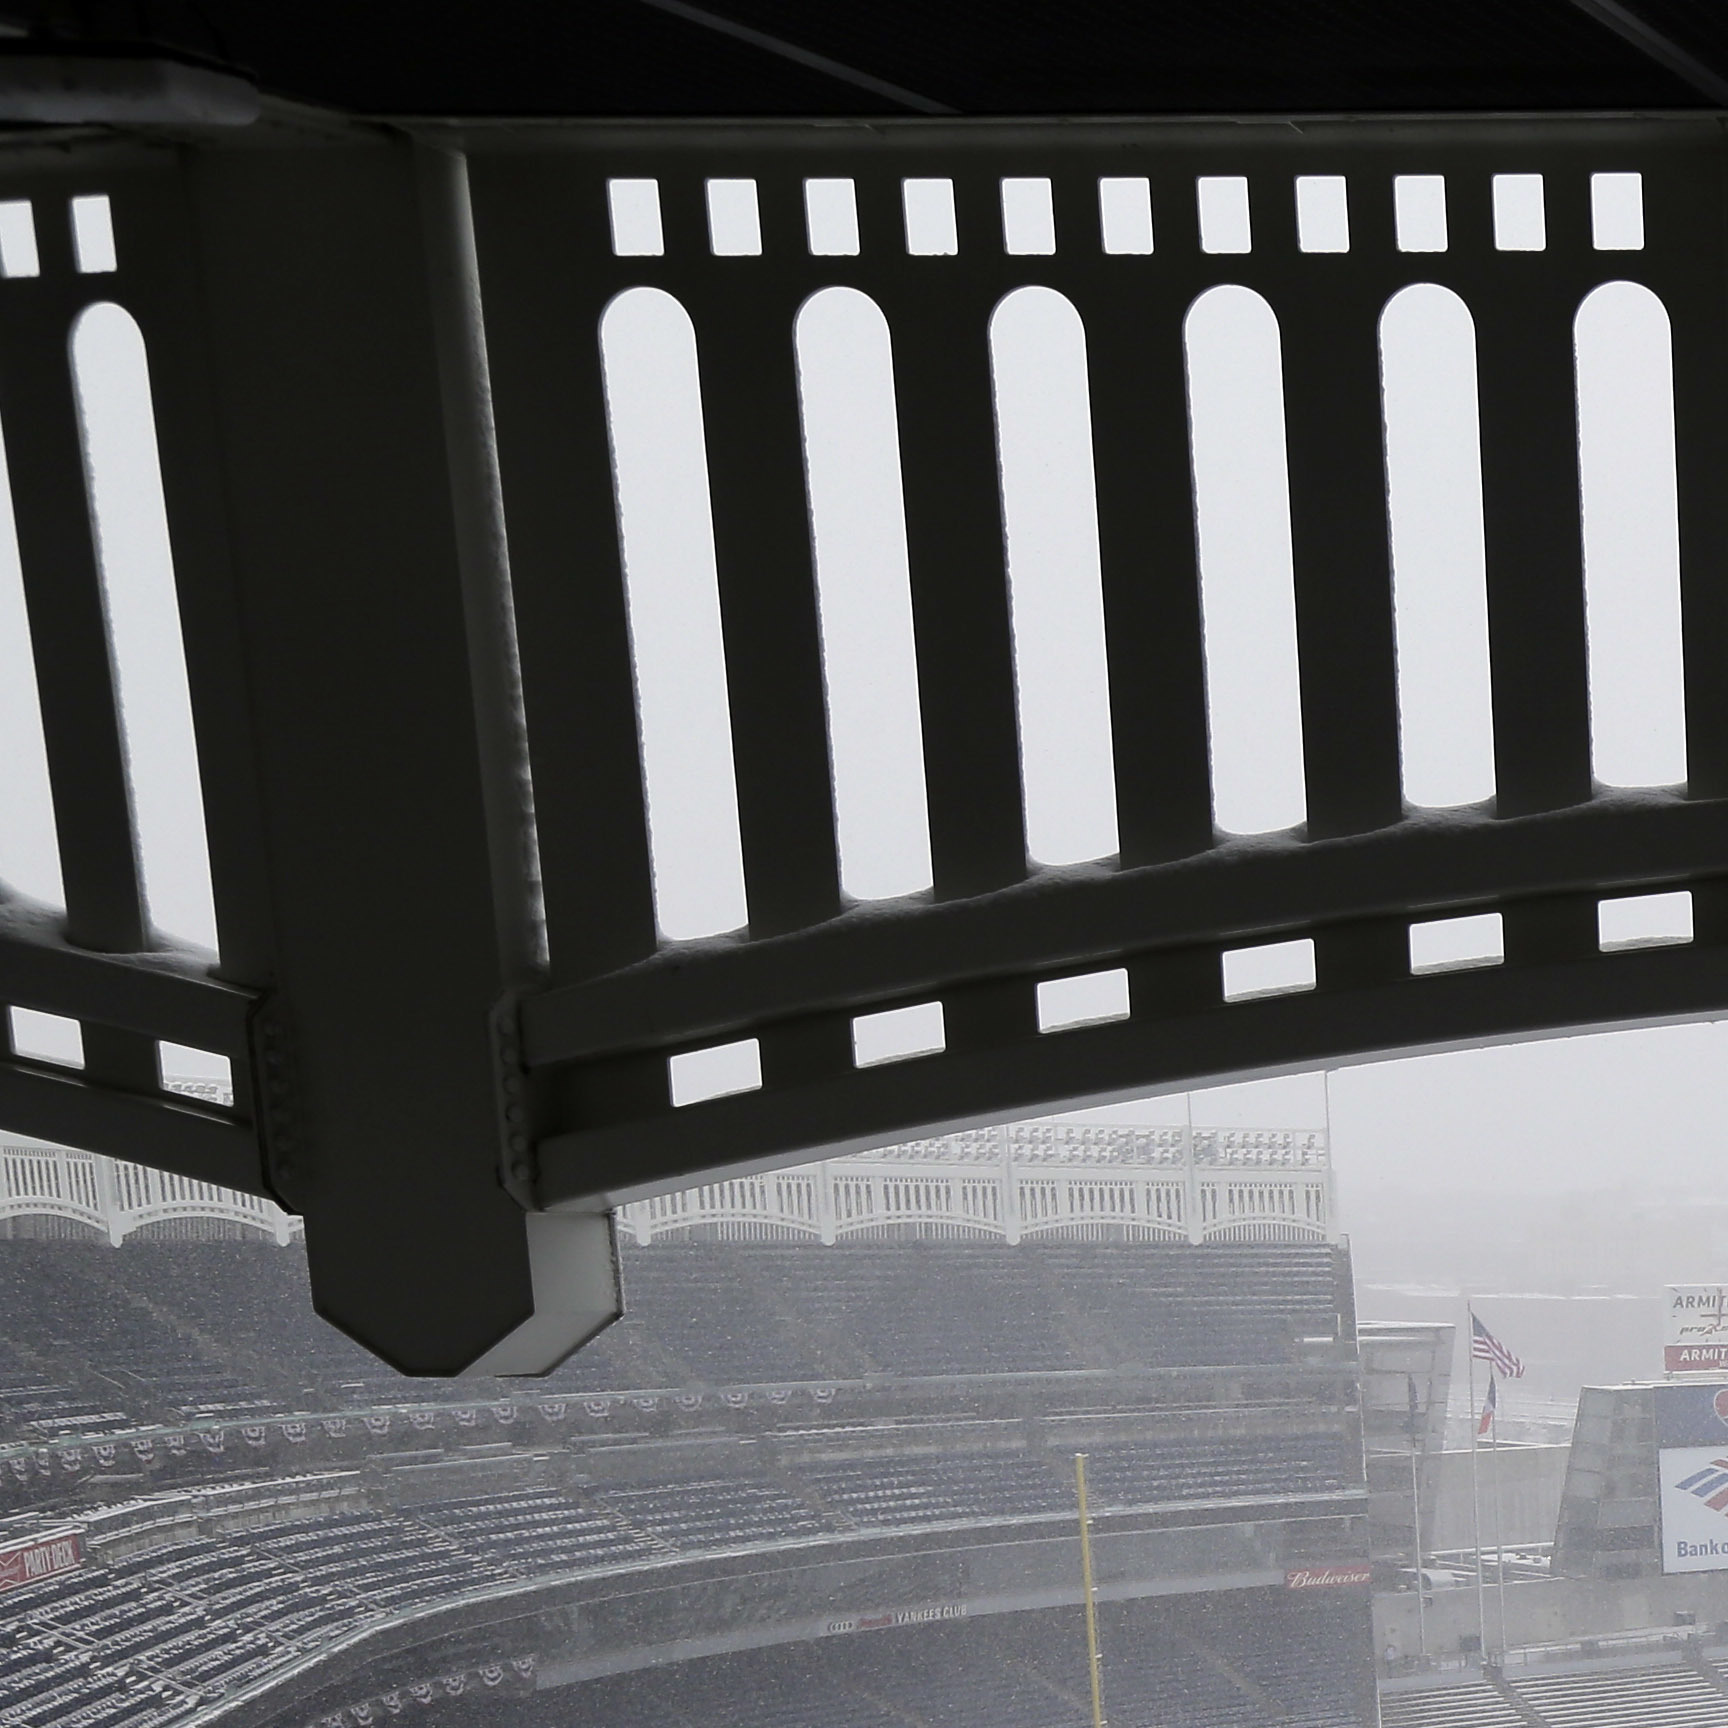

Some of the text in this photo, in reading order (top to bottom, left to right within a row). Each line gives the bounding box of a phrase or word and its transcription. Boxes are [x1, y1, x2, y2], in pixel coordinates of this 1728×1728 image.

[1677, 1539, 1719, 1557] Bank
[1288, 1570, 1369, 1587] Budweiser
[896, 1607, 941, 1624] YANKEES
[943, 1604, 967, 1617] CLUB
